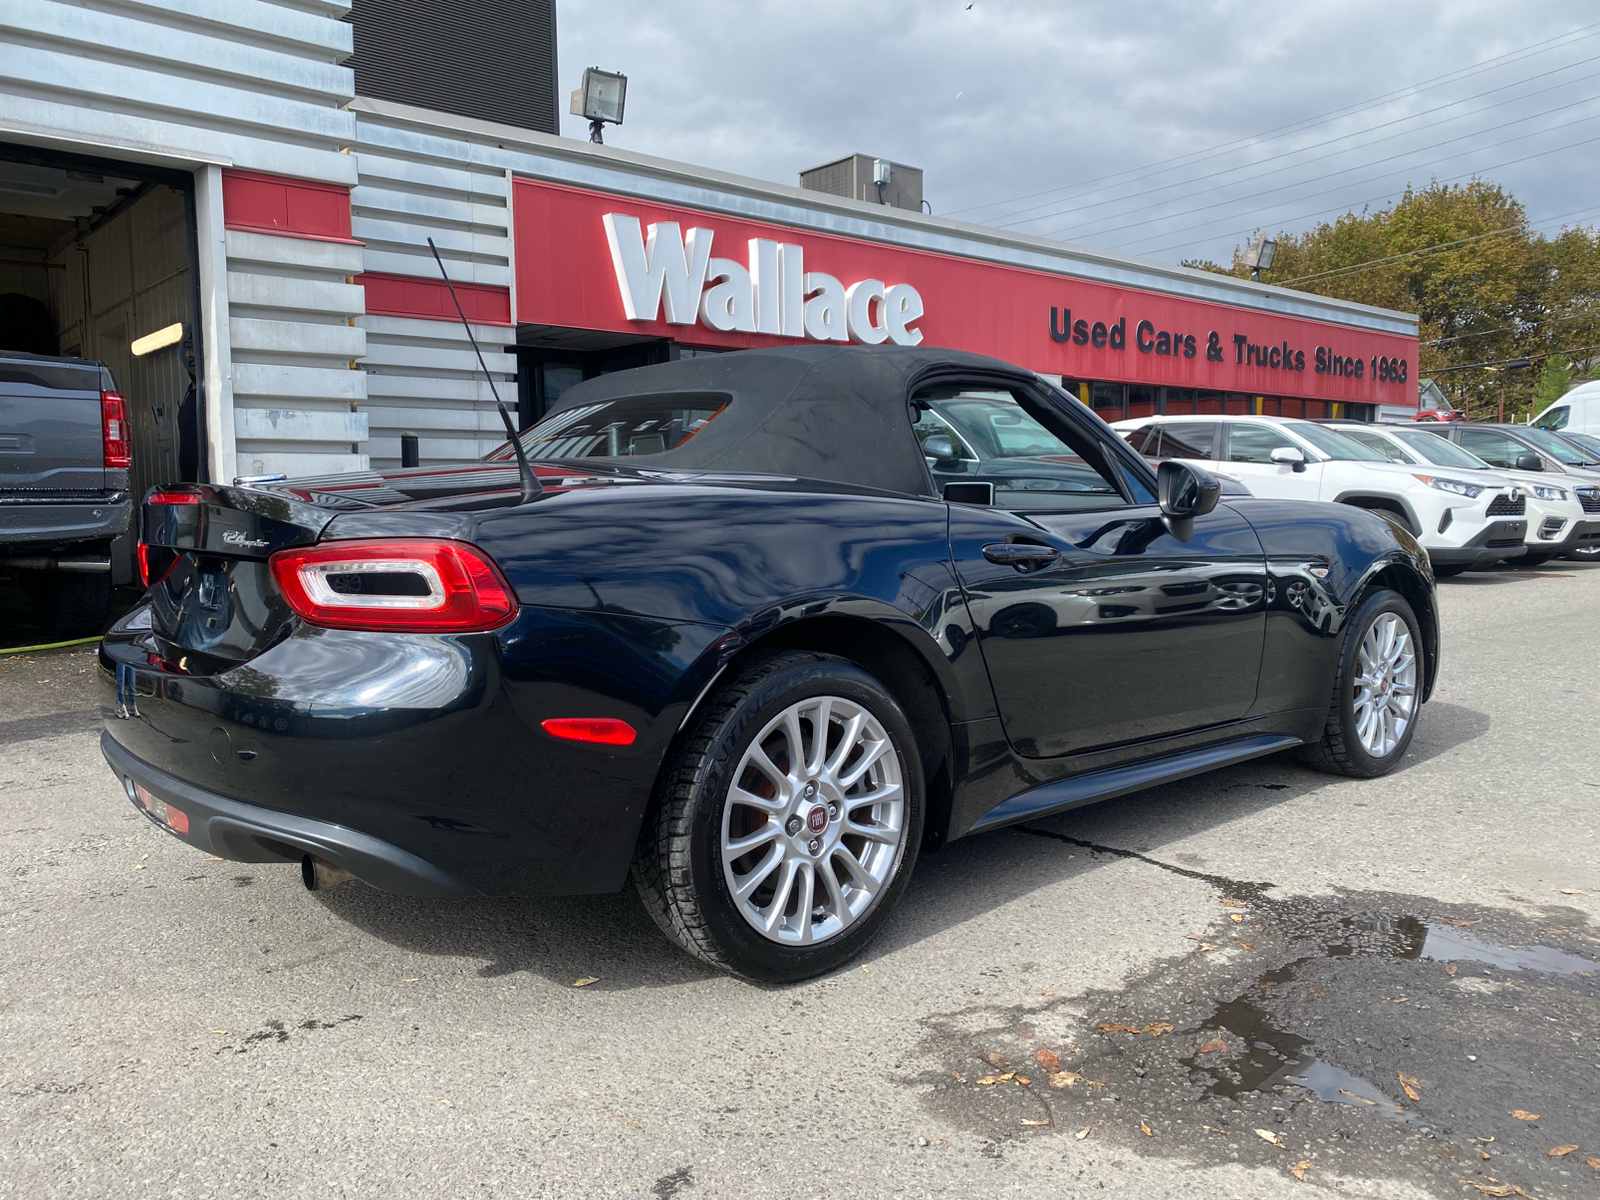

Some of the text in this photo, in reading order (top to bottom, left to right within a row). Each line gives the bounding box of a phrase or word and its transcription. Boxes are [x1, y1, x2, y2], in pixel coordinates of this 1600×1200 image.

[602, 212, 925, 346] Wallace
[1049, 306, 1408, 384] Used Cars & Trucks Since 1963
[811, 811, 824, 827] FIAT
